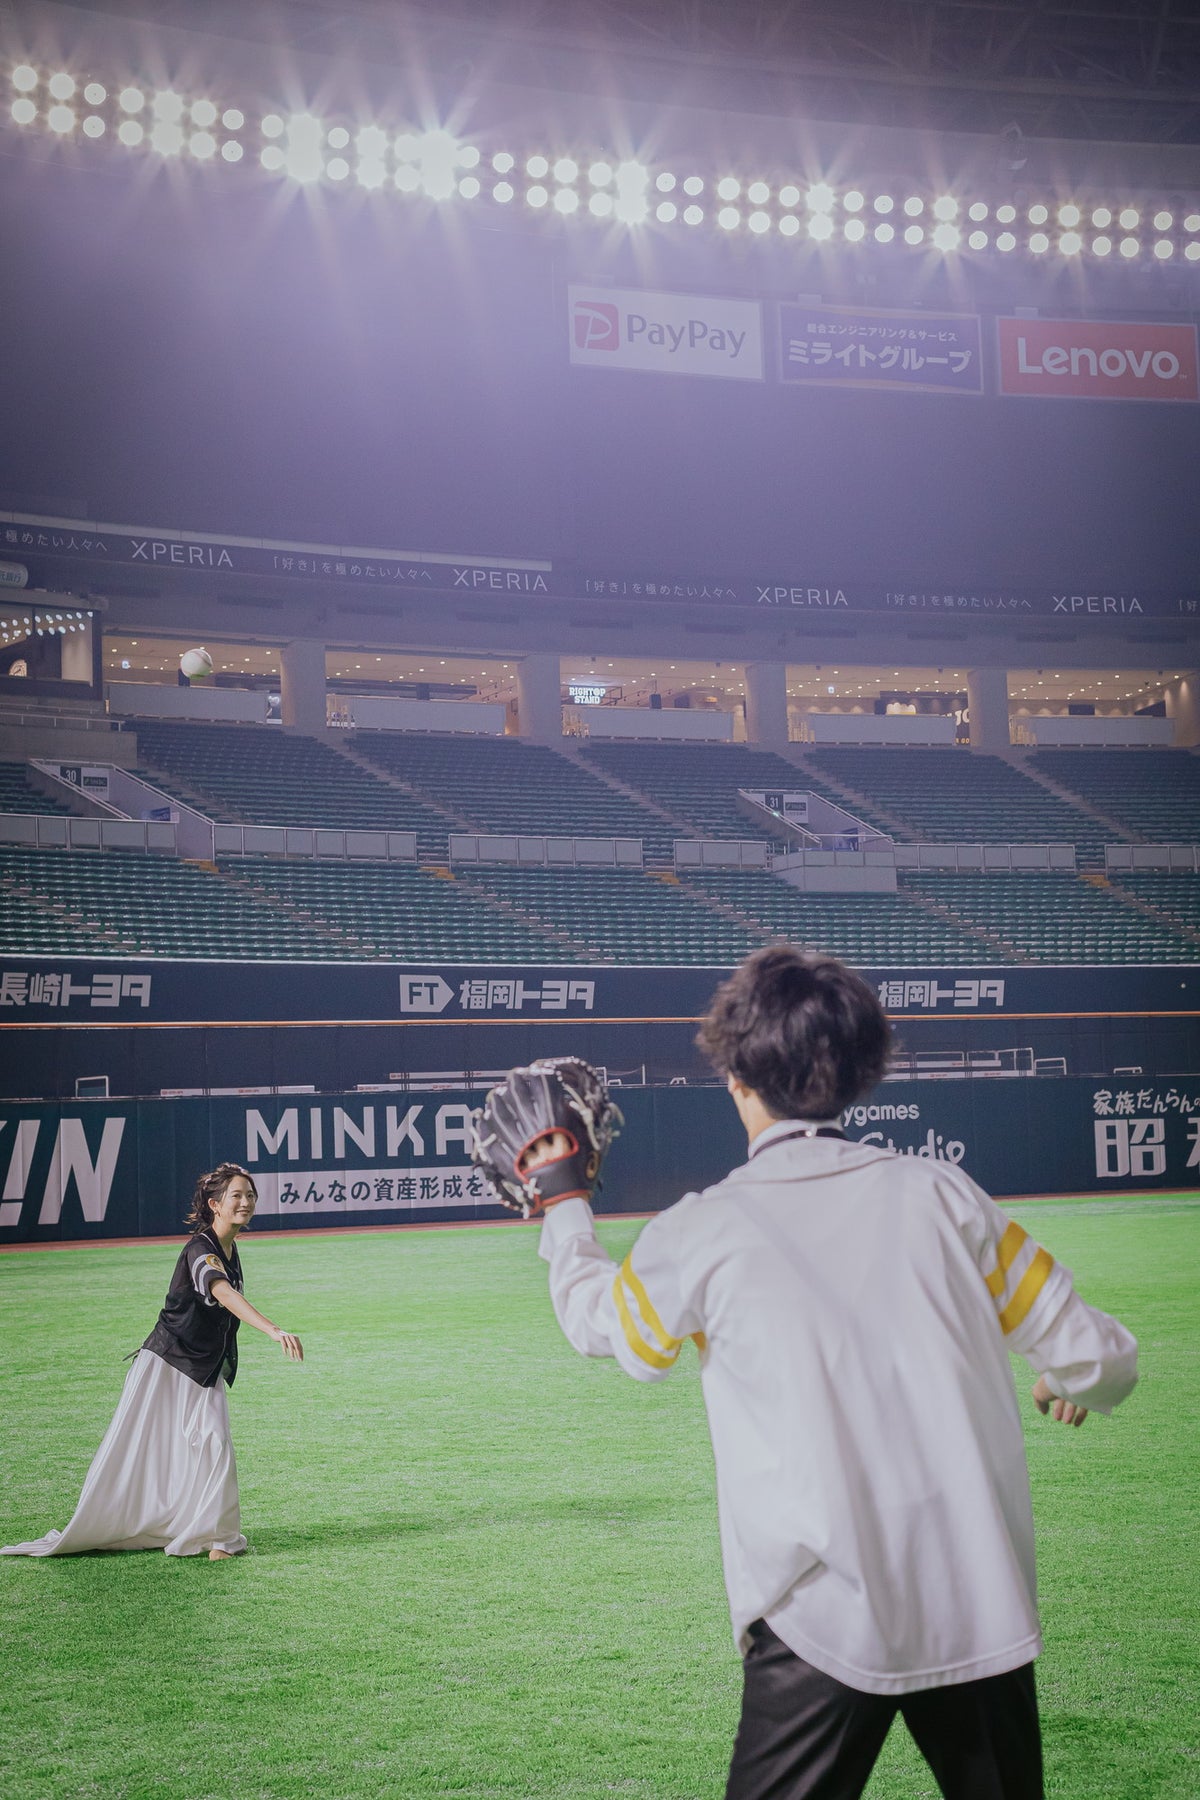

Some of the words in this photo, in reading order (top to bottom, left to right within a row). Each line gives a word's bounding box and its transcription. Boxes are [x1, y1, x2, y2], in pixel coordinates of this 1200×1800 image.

[626, 313, 747, 359] PayPay
[788, 338, 972, 374] ミライトグループ
[1017, 336, 1180, 380] Lenovo
[130, 540, 233, 568] XPERIA
[273, 556, 432, 581] 「好き」を極めたい人々へ
[453, 568, 548, 592] XPERIA
[756, 586, 849, 606] XPERIA
[1052, 595, 1144, 613] XPERIA
[574, 696, 600, 704] STAND
[65, 770, 77, 782] 30
[770, 797, 779, 808] 31
[0, 972, 152, 1007] 長崎トヨタ
[459, 980, 595, 1010] 福岡トヨタ
[878, 979, 1005, 1008] 福岡トヨタ
[280, 1174, 494, 1205] みんなの資産形成を
